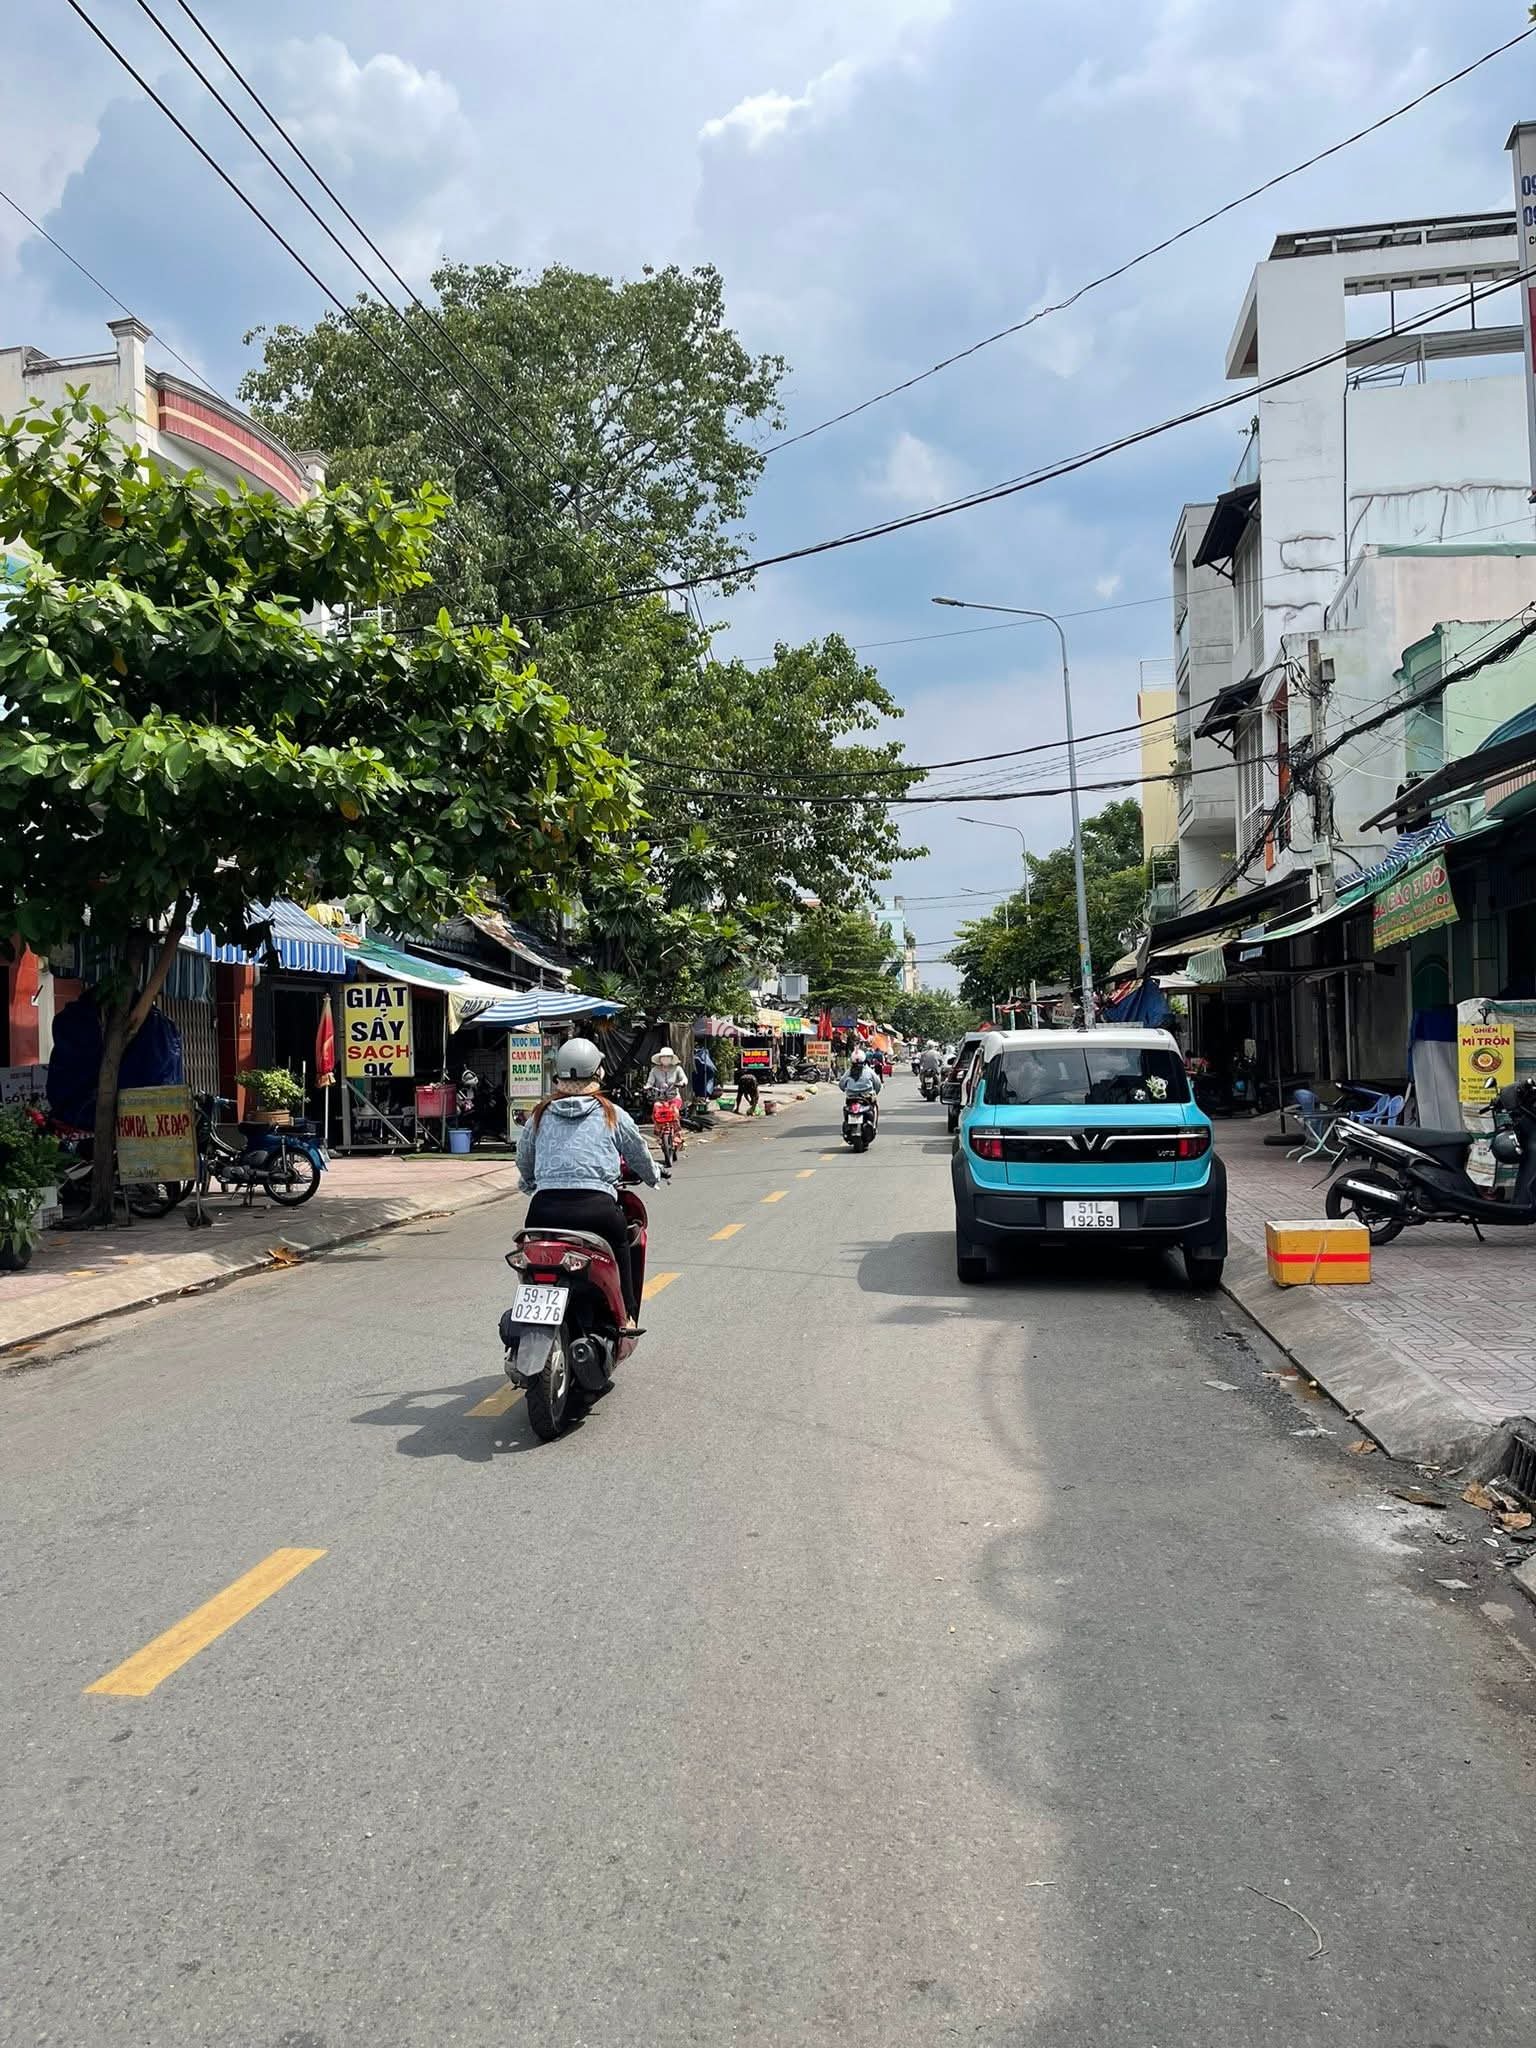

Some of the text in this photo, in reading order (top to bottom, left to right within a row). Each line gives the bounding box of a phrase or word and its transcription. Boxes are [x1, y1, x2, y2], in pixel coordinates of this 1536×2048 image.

[346, 983, 408, 1012] GIẶT
[351, 1013, 405, 1042] SẤY
[1462, 1035, 1511, 1048] MÌ TRỘN
[347, 1044, 410, 1062] SẠCH
[363, 1062, 394, 1077] 9K
[512, 1064, 528, 1074] RAU
[1078, 1202, 1103, 1214] 51L
[1070, 1215, 1114, 1227] 192.69
[515, 1303, 561, 1322] 023.76
